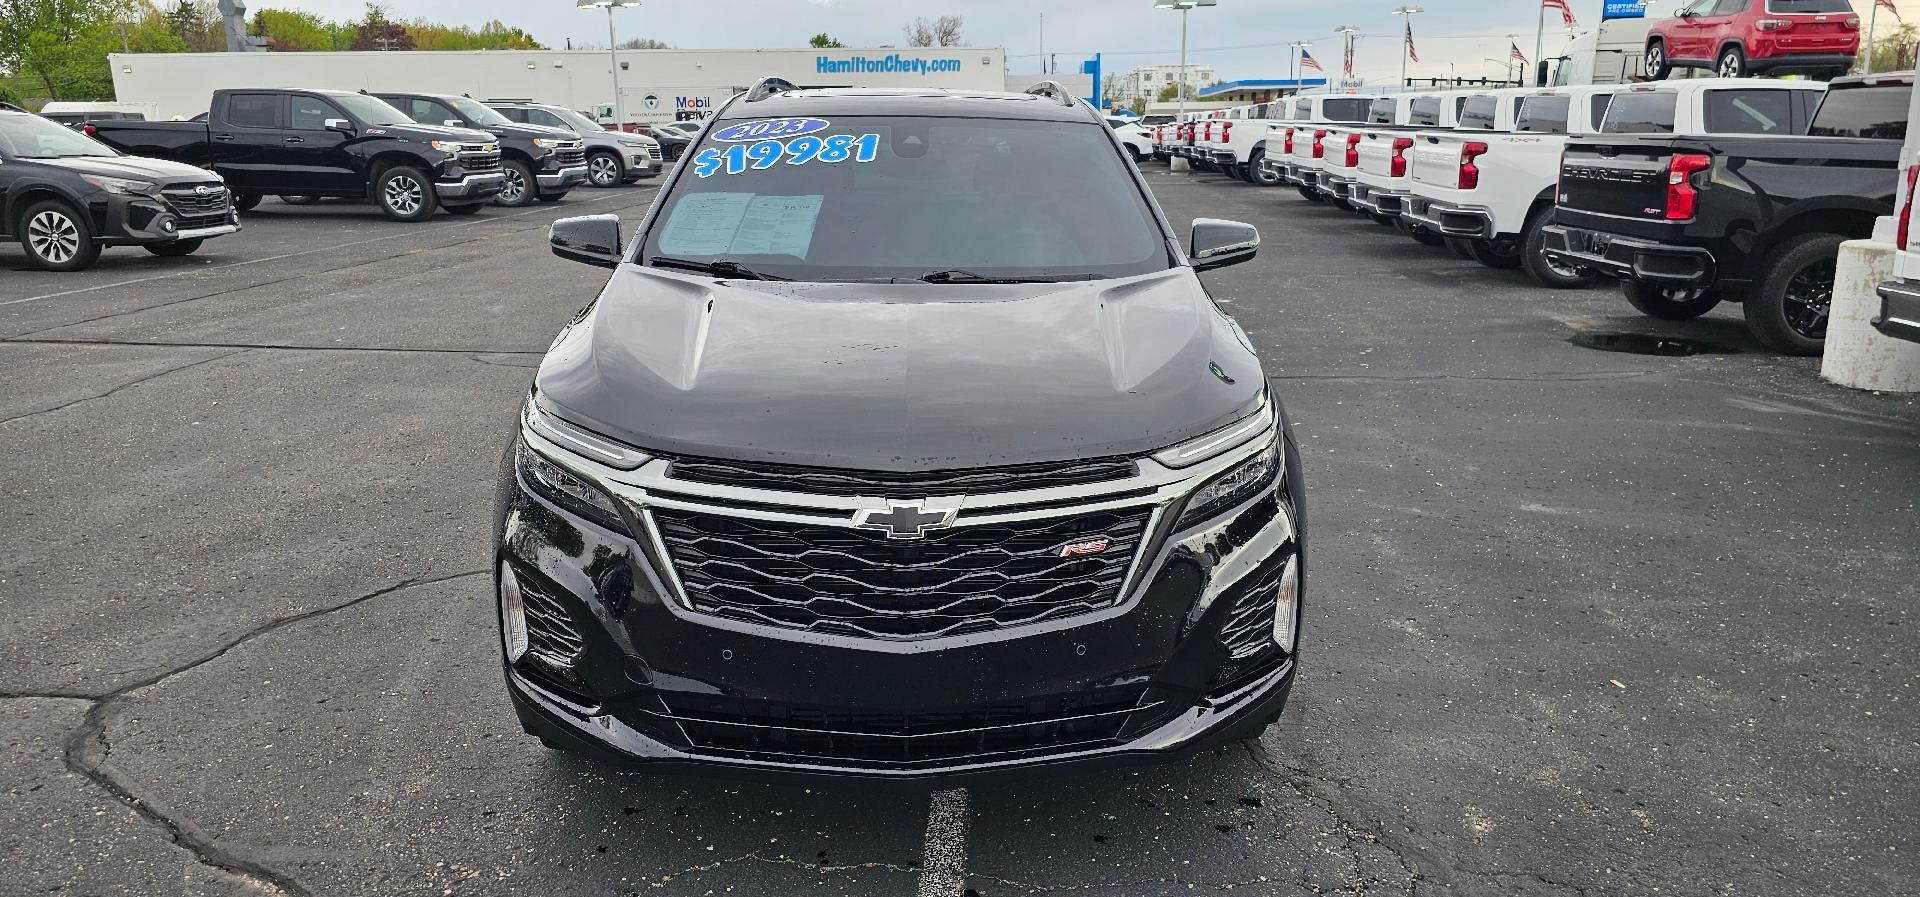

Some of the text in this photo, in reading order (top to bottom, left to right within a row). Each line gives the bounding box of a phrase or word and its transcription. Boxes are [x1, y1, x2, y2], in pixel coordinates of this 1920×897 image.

[816, 54, 961, 75] HamiltonChevy.com
[1340, 80, 1363, 88] Mobil
[675, 96, 711, 108] Mobil
[728, 119, 809, 139] 2023
[693, 133, 880, 178] $19981
[1563, 167, 1657, 184] CHEVROLET
[1060, 539, 1109, 557] RS
